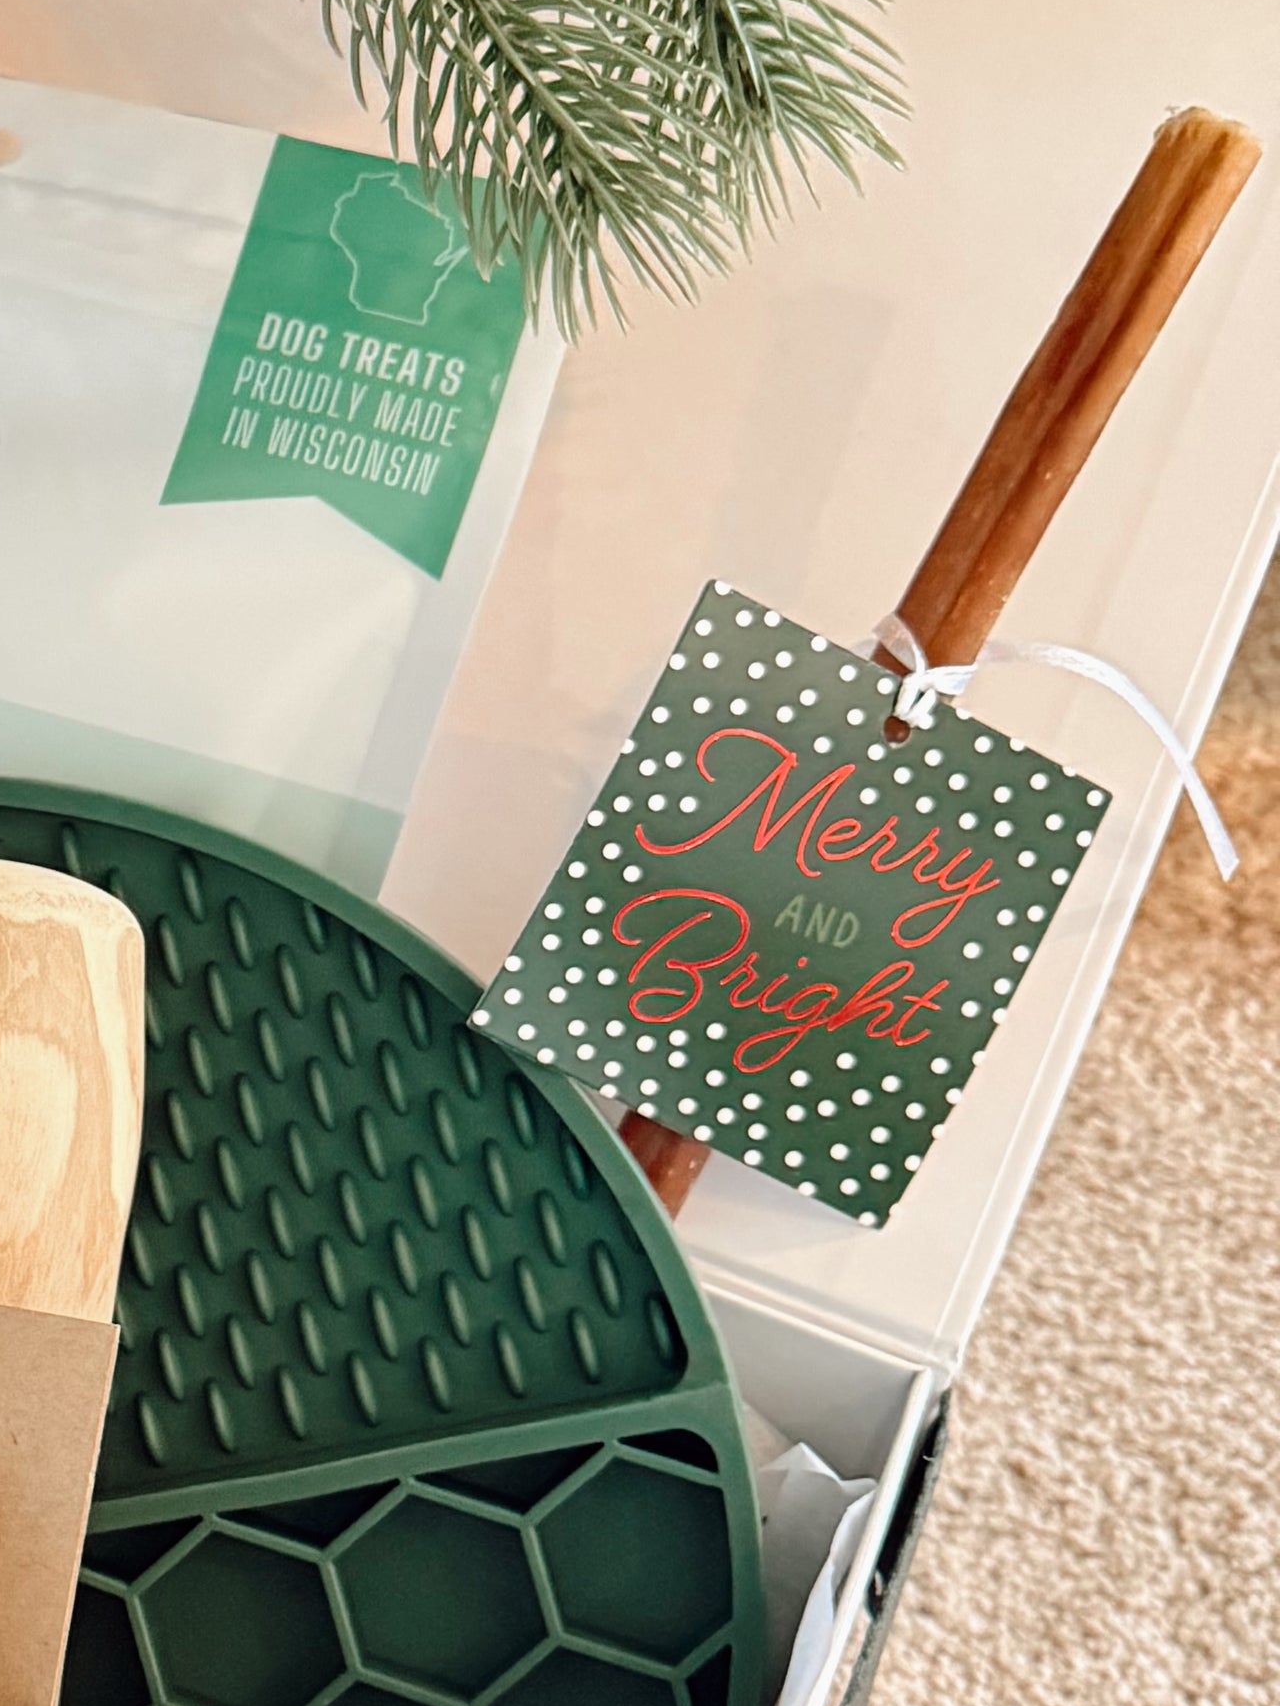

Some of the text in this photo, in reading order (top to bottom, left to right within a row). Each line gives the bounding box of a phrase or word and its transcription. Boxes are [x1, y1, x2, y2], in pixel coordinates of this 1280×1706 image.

[256, 312, 466, 397] DOG TREATS
[233, 355, 463, 448] PROUDLY MADE
[222, 406, 441, 496] IN WISCONSIN
[635, 728, 1001, 949] Merry
[774, 895, 861, 949] AND
[612, 888, 950, 1074] Bright
